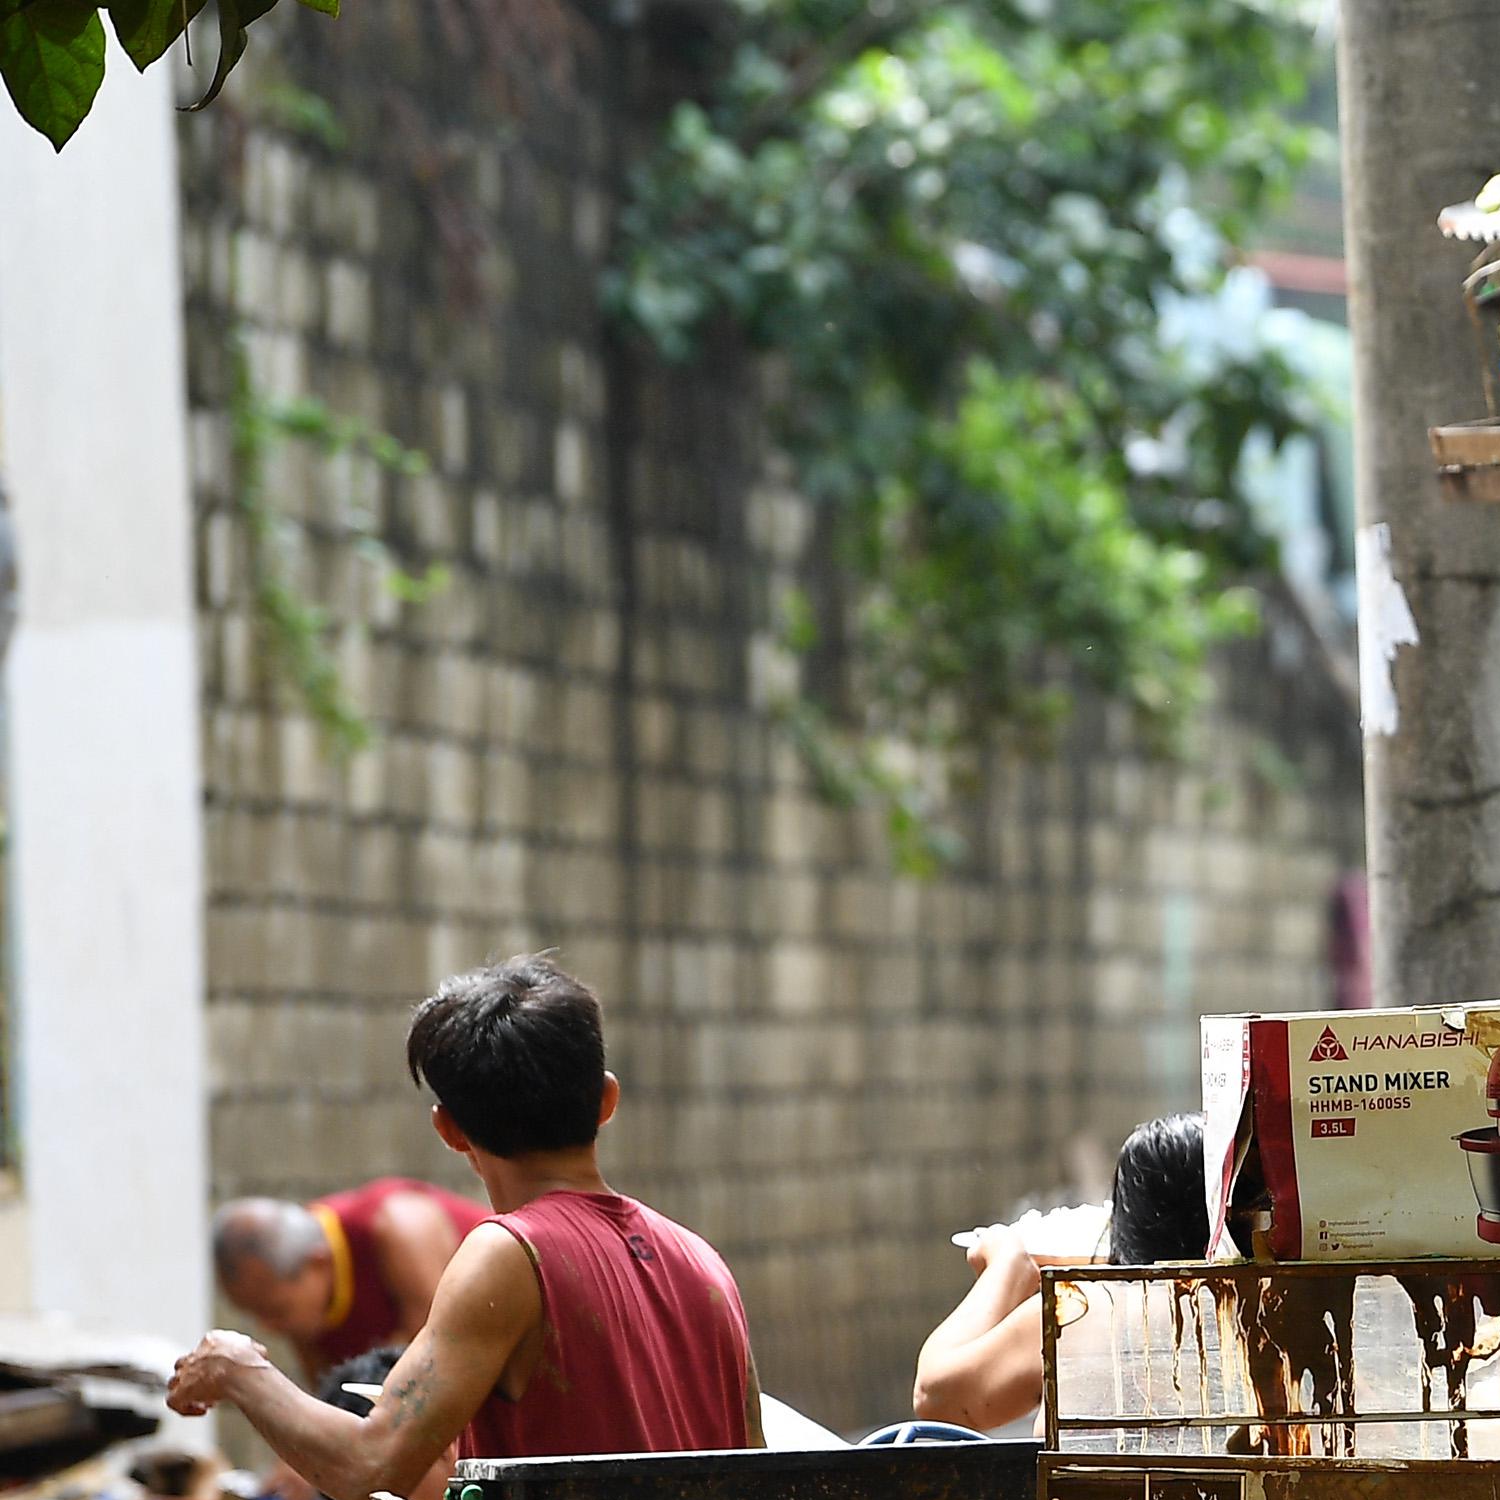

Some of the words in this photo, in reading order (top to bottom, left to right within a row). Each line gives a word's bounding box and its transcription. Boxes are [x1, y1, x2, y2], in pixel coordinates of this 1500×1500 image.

[1352, 1030, 1480, 1051] HANABISHI
[1309, 1073, 1378, 1094] STAND
[1385, 1070, 1450, 1091] MIXER
[1310, 1096, 1411, 1113] HHMB-1600SS
[1320, 1122, 1347, 1134] 3.5L
